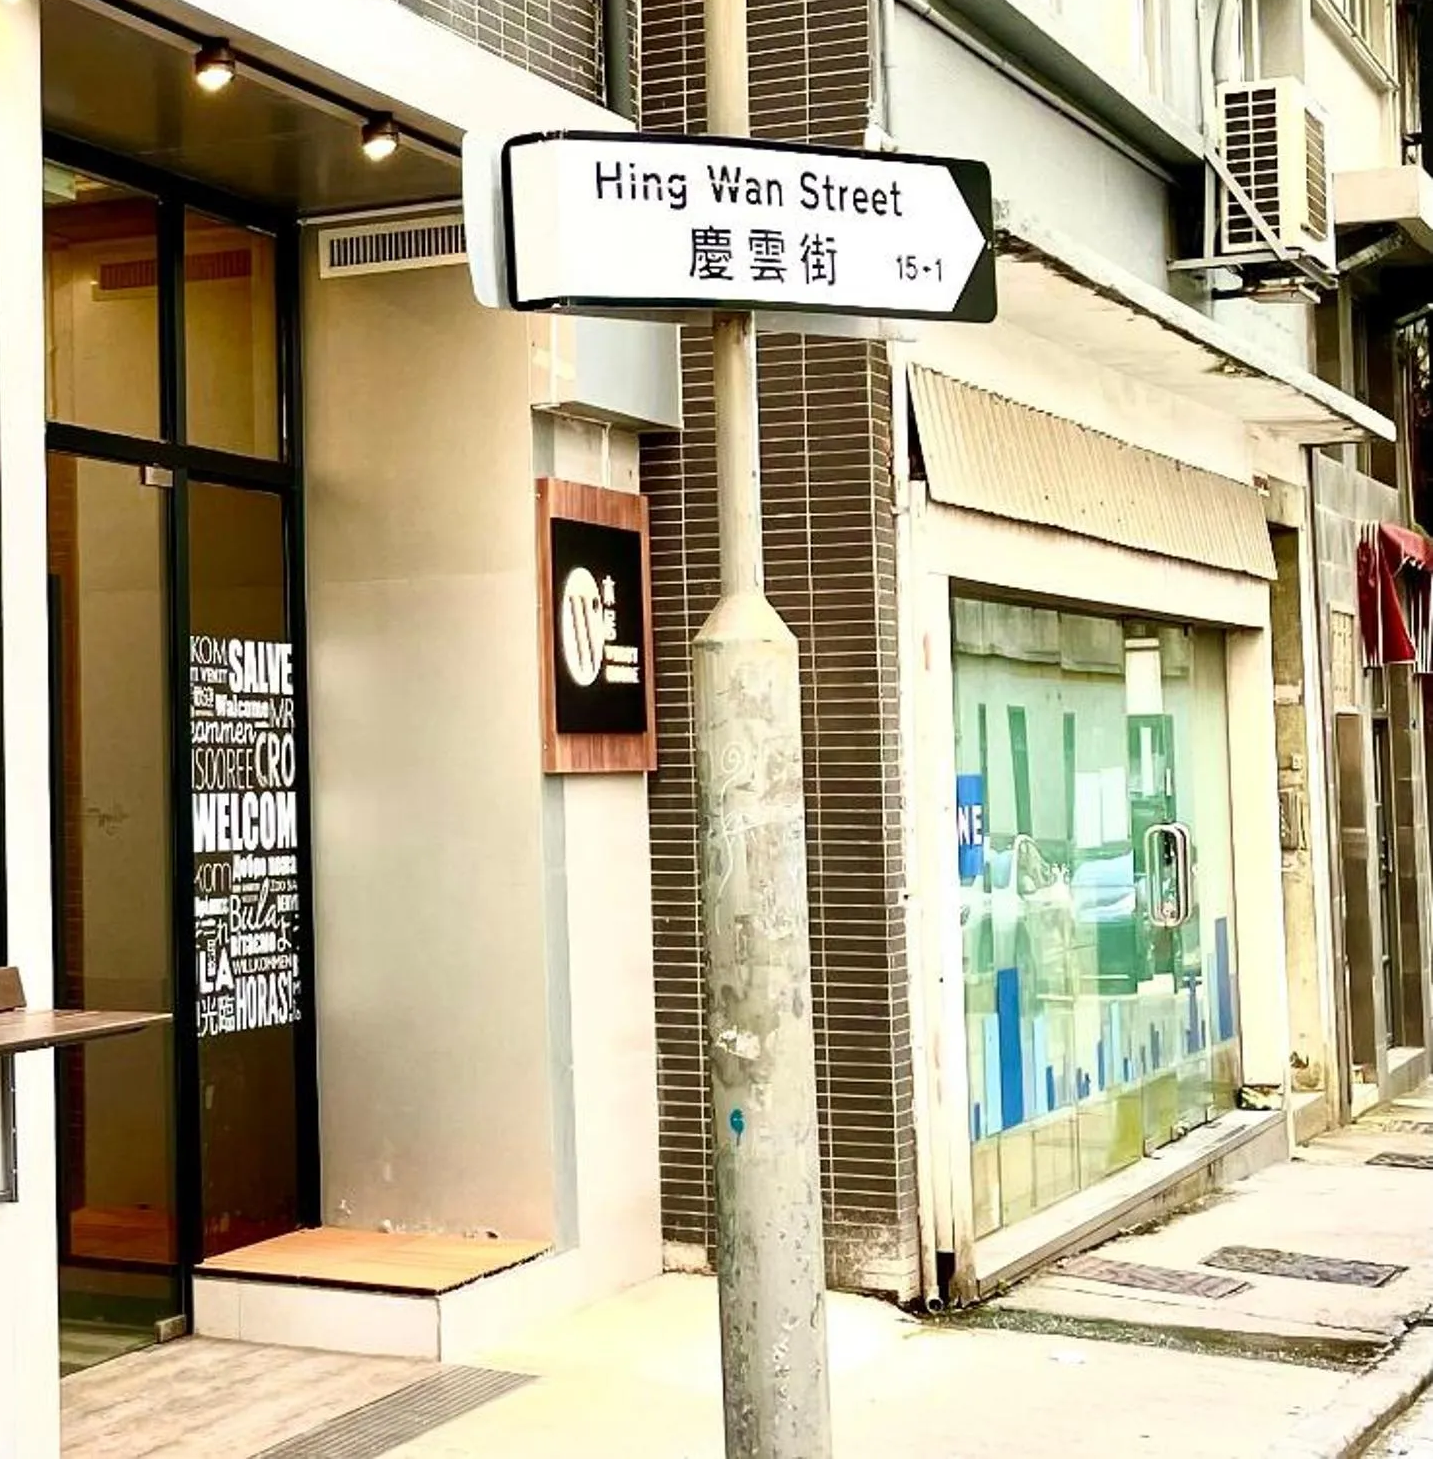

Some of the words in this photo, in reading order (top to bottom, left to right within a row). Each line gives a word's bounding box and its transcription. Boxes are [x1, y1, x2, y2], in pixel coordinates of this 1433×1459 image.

[595, 160, 687, 210] Hing
[707, 164, 784, 208] Wan
[800, 173, 903, 218] Street
[689, 225, 837, 286] 慶雲街
[228, 638, 294, 695] SALVE
[255, 731, 296, 788] CRO
[192, 791, 297, 852] WELCOM
[230, 876, 280, 933] Bula
[235, 970, 294, 1031] HORAS!
